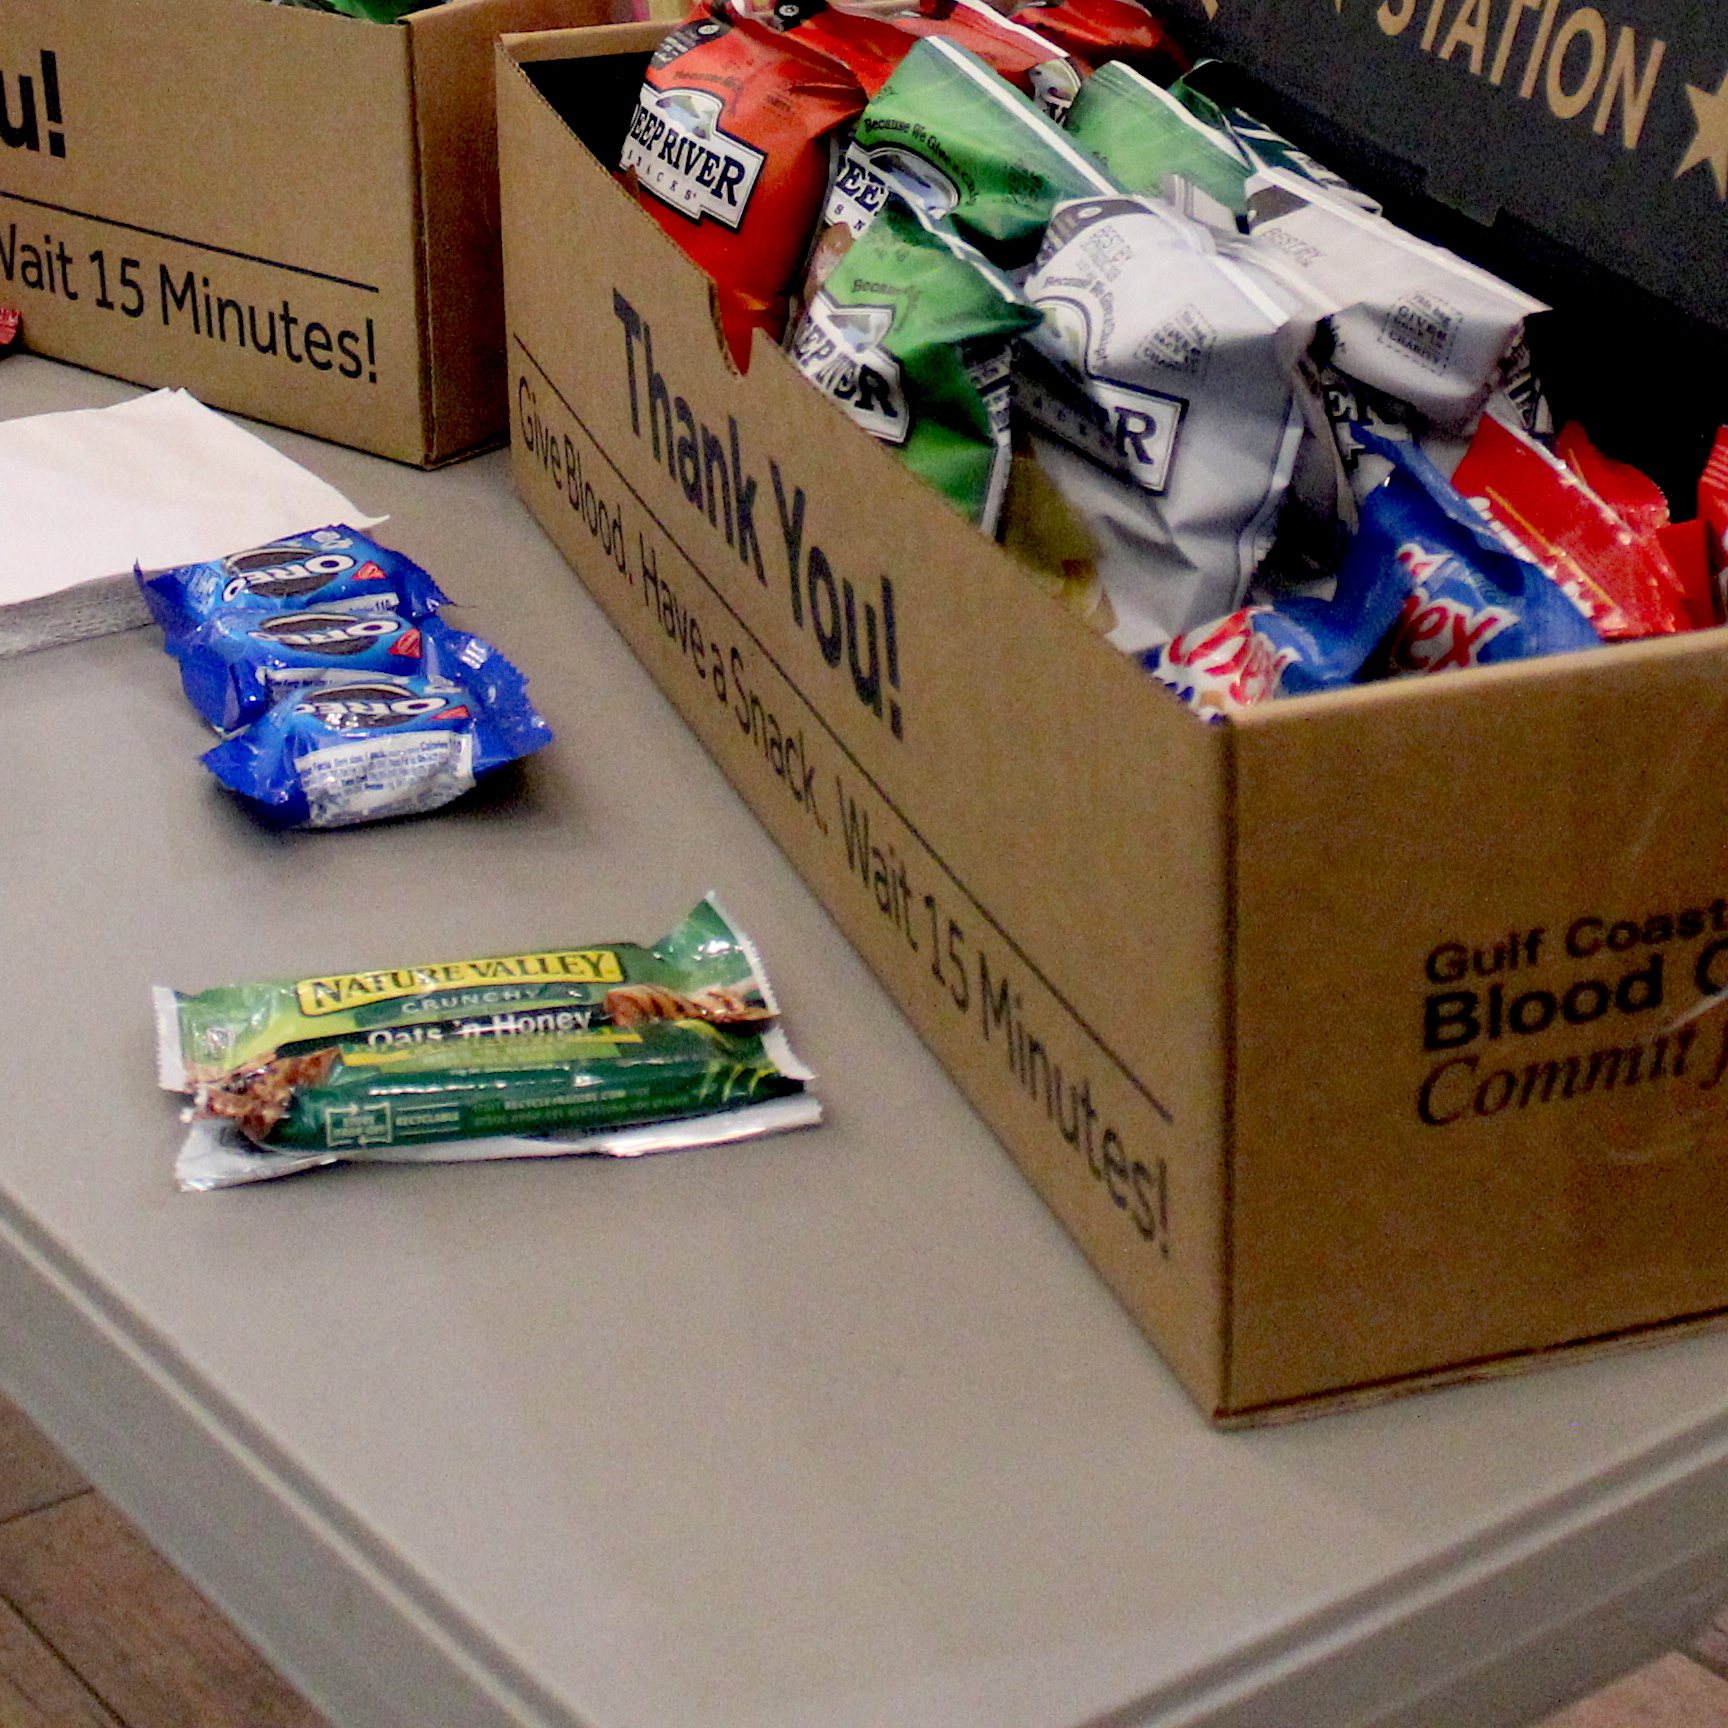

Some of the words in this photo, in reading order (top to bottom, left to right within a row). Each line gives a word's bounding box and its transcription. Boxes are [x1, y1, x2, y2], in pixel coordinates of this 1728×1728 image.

[657, 127, 747, 208] RIVER
[89, 249, 145, 319] 15
[159, 263, 378, 384] Minutes!
[612, 287, 768, 588] Thank
[769, 455, 903, 742] You!
[222, 552, 356, 604] OREO
[518, 375, 563, 491] Give
[564, 433, 634, 586] Blood.
[639, 531, 706, 680] Have
[710, 642, 729, 707] a
[730, 646, 829, 837] Snack.
[836, 774, 919, 953] Wait
[924, 893, 970, 1014] 15
[979, 950, 1170, 1261] Minutes!
[311, 962, 463, 1009] NATURE
[471, 952, 606, 980] VALLEY
[1425, 928, 1547, 985] Gulf
[368, 1025, 444, 1047] Oats
[492, 1009, 594, 1038] Honey
[401, 987, 541, 1014] CRUNCHY
[1423, 953, 1666, 1052] Blood
[1416, 1018, 1700, 1127] Commit
